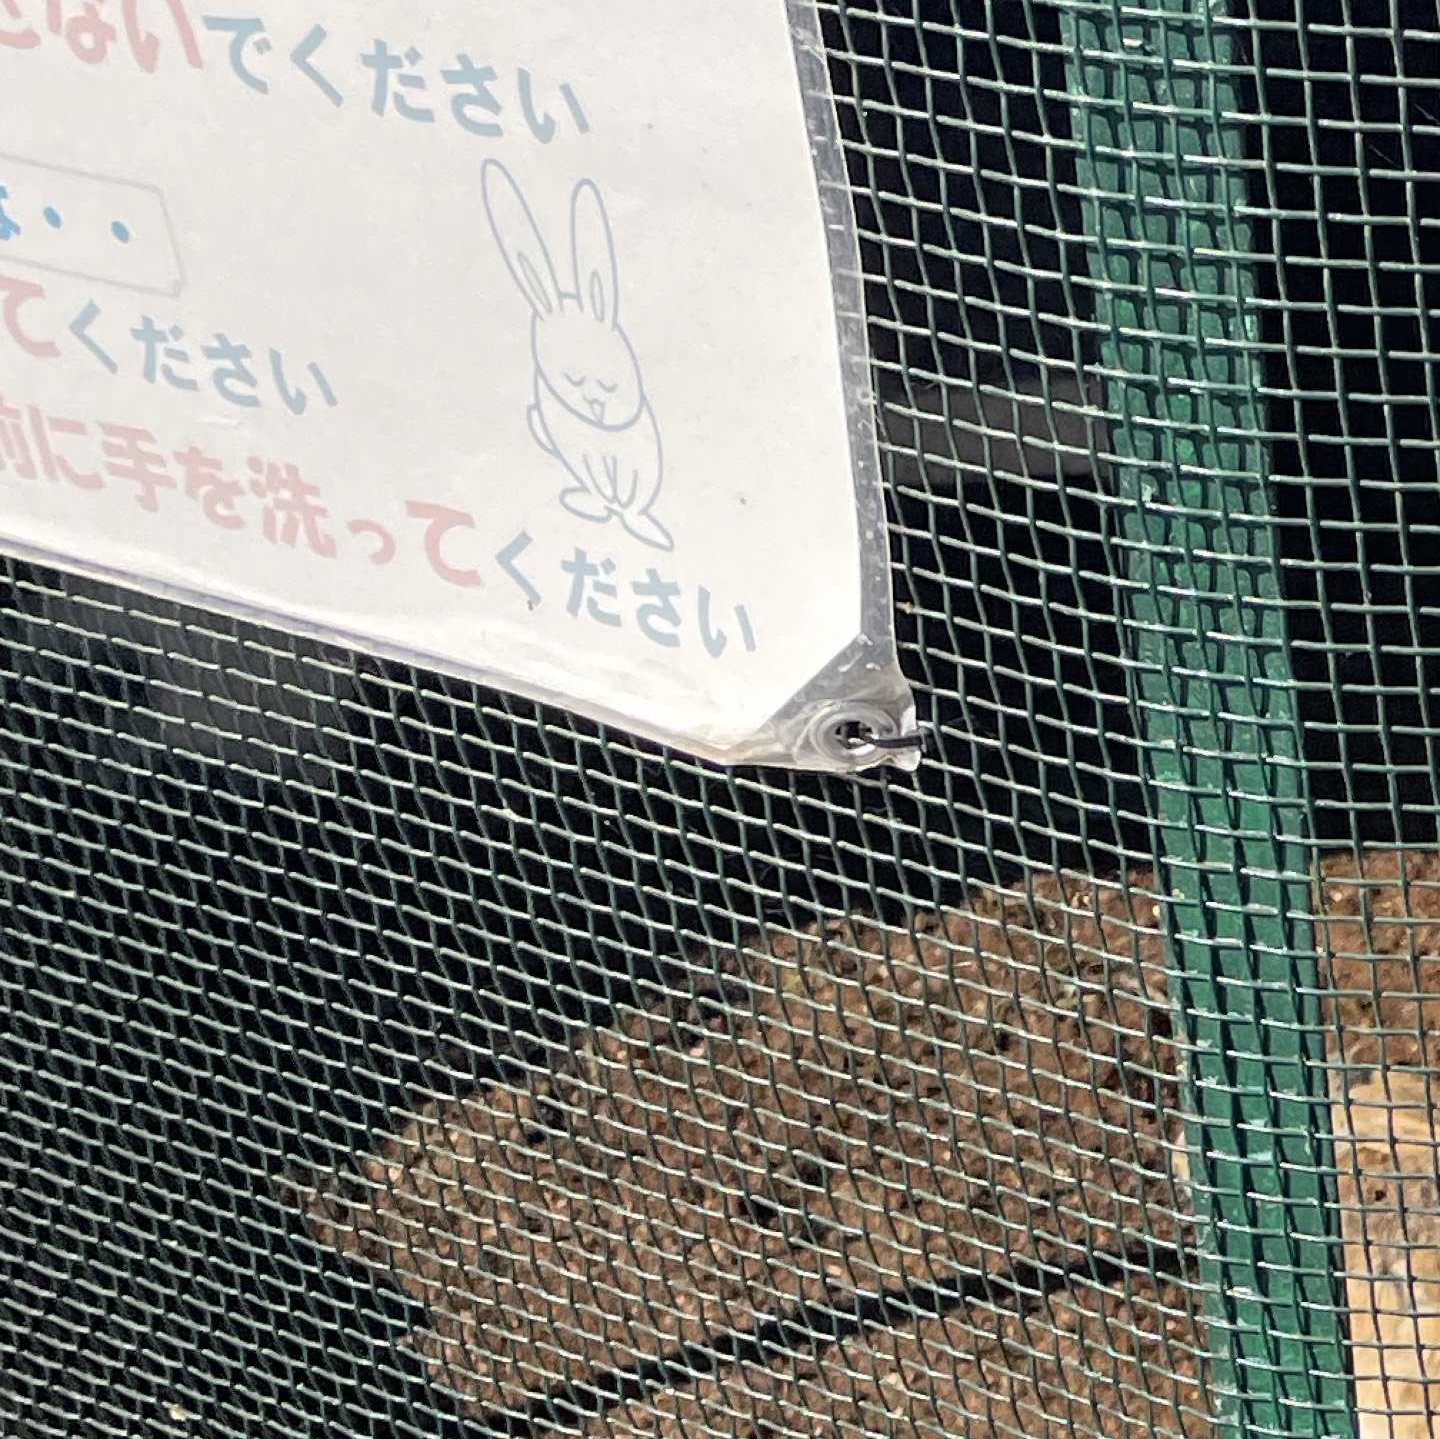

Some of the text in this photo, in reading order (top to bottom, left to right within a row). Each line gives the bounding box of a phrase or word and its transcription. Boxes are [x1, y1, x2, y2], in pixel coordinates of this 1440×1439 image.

[0, 276, 338, 415] てください
